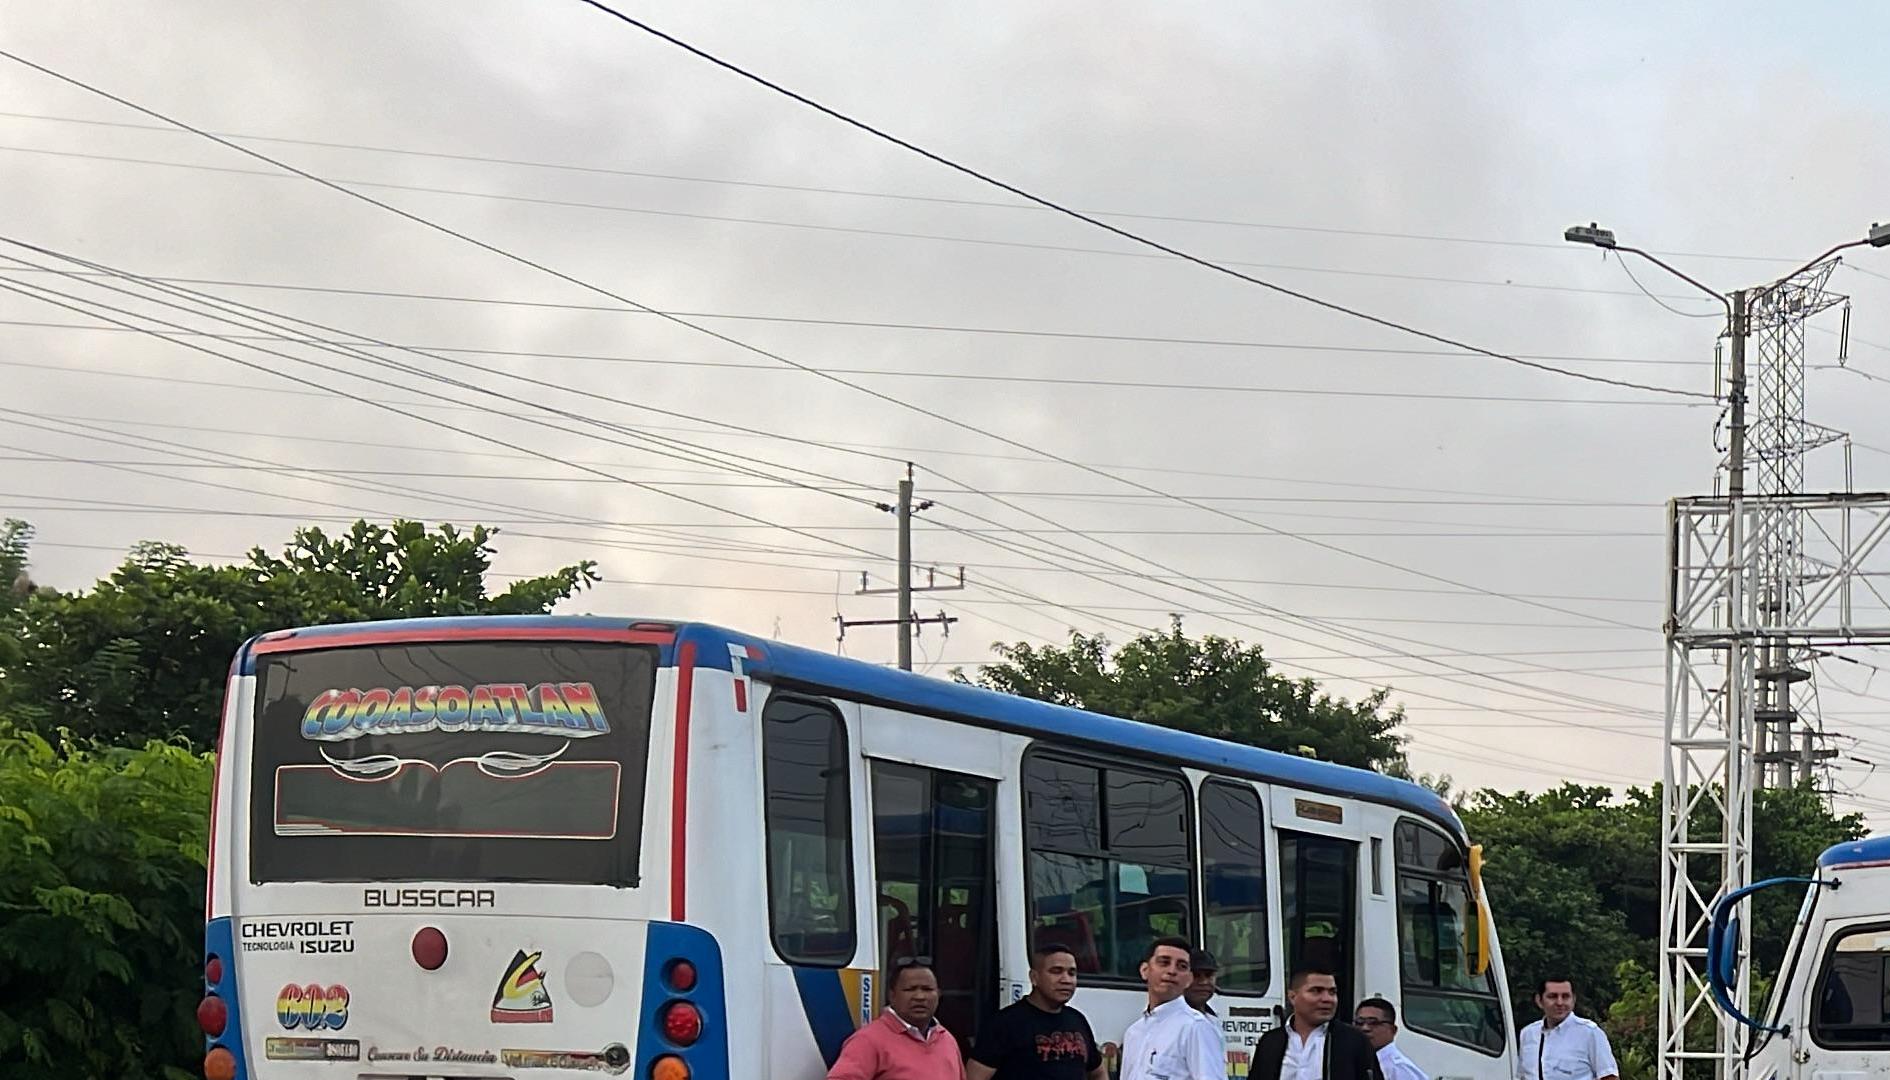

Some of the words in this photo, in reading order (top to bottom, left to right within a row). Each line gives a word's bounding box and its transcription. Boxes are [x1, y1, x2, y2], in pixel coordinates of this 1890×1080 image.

[301, 682, 611, 742] COOASOATLAN
[364, 889, 495, 908] BUSSCAR
[242, 920, 355, 938] CHEVROLET
[242, 941, 294, 951] TECNOLOGIA
[299, 939, 355, 954] ISUZU
